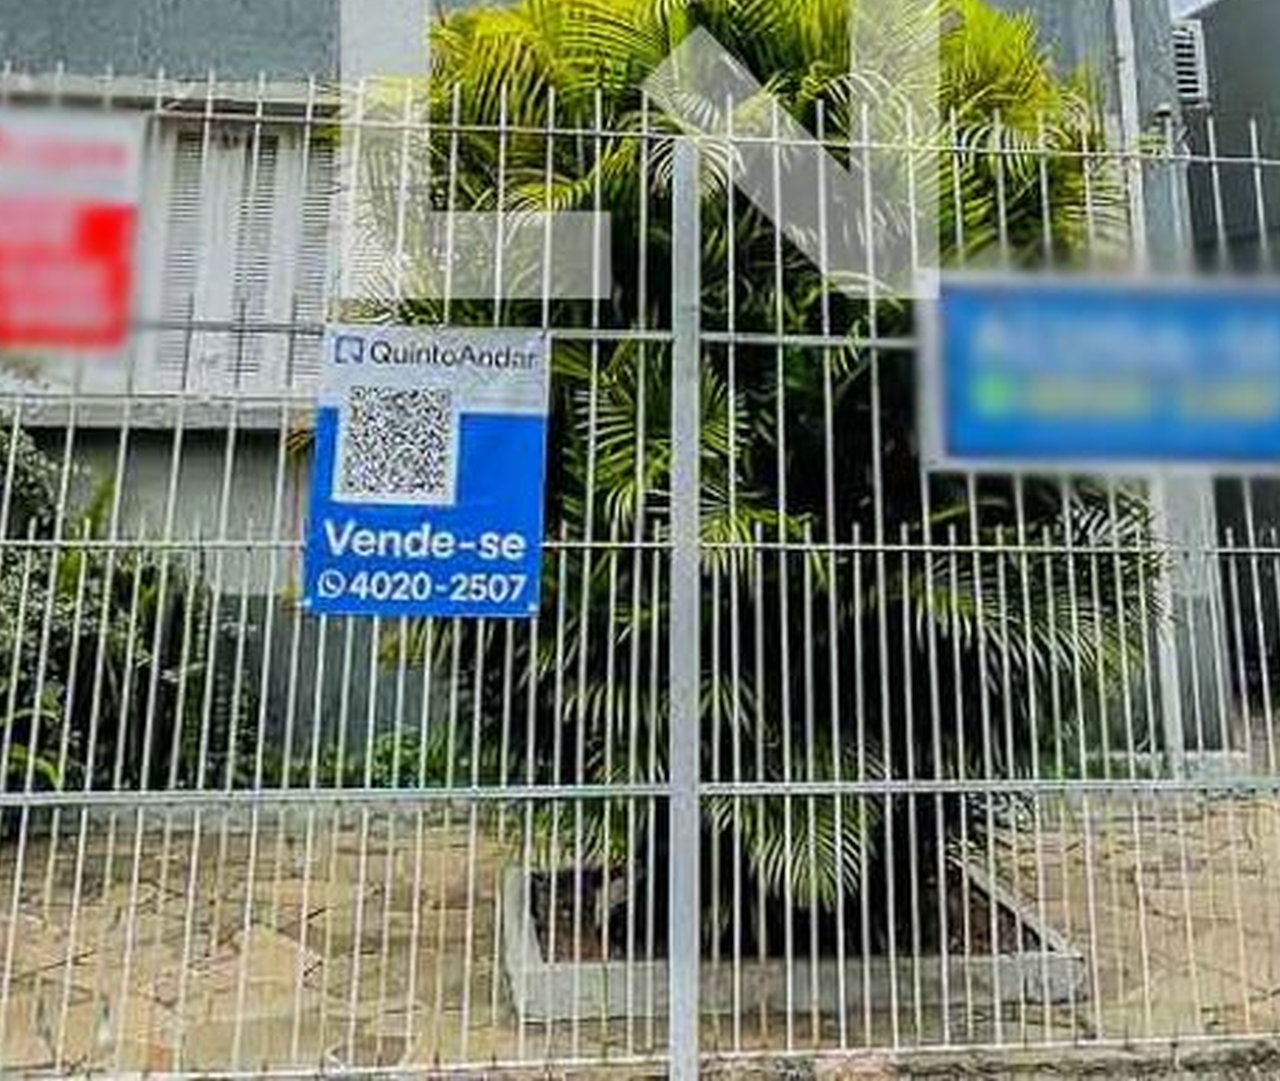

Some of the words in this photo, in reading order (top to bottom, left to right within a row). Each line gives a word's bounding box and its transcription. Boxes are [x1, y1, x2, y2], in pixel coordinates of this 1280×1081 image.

[370, 341, 536, 367] QuintoAndar
[325, 520, 526, 560] Vende-se
[349, 572, 527, 602] 4020-2507
